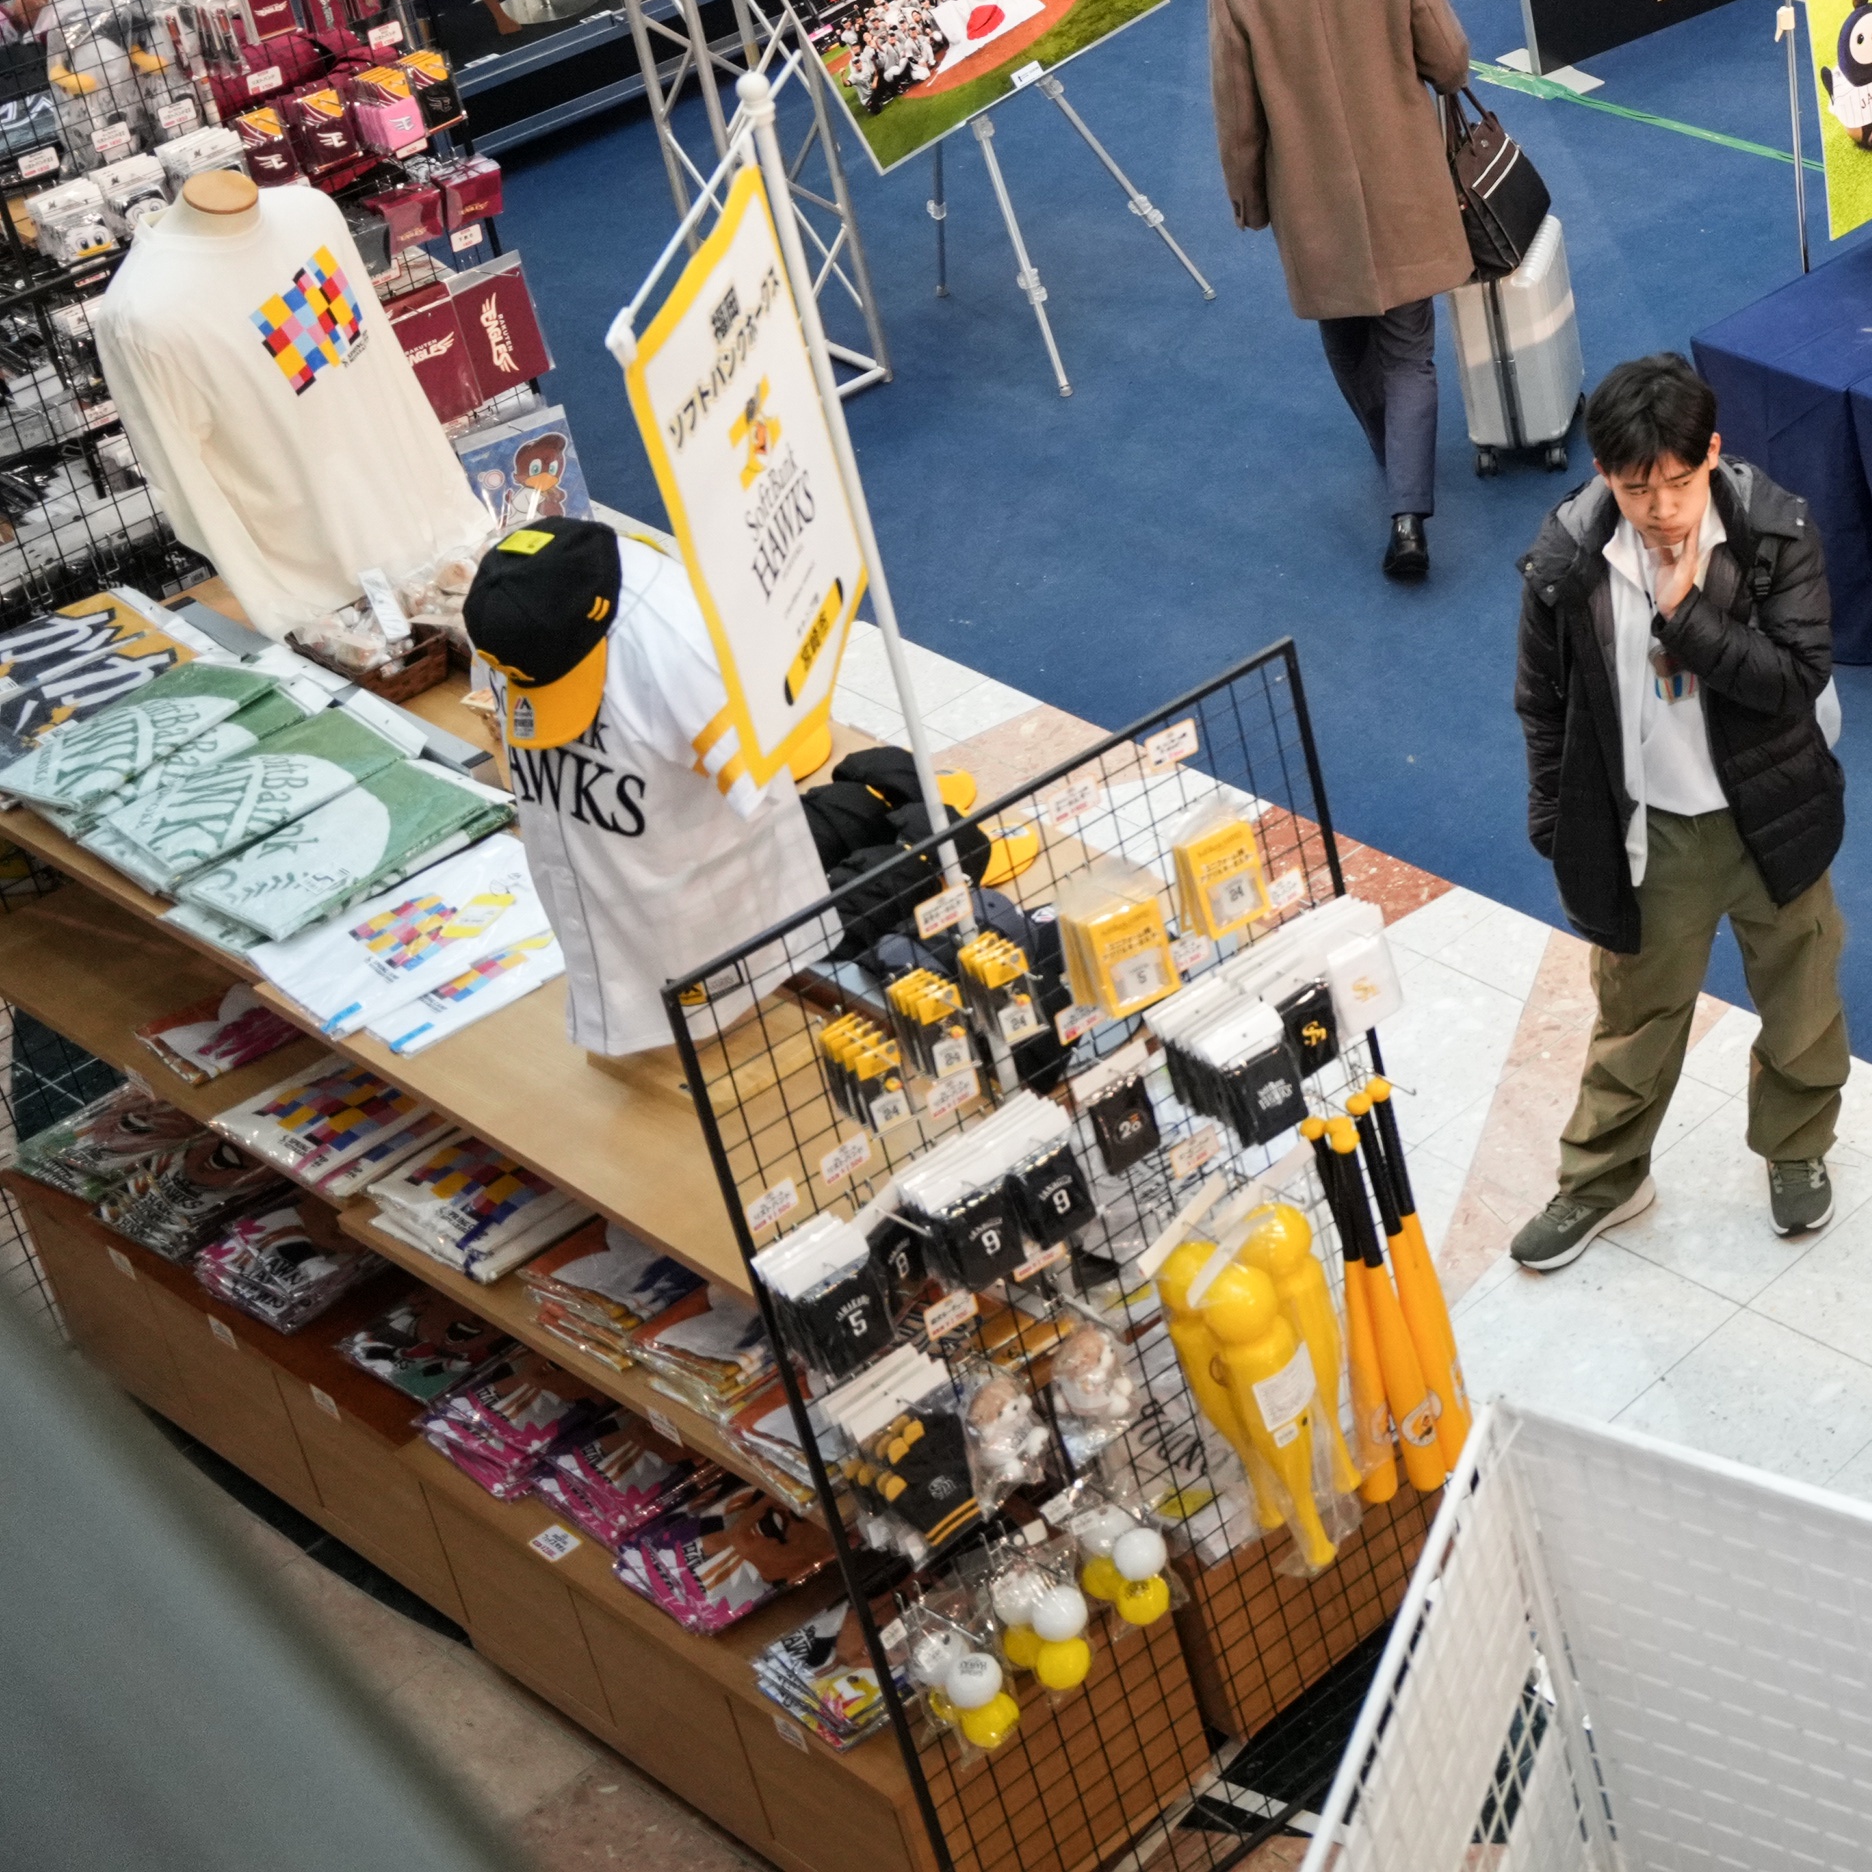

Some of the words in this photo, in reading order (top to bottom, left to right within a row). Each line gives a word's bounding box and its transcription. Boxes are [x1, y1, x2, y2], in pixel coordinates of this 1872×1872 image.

[498, 313, 513, 352] RAKUTEN
[668, 264, 782, 450] ソフトバンクホークス
[744, 443, 800, 542] SoftBank
[750, 470, 817, 605] HAWKS
[1051, 1188, 1072, 1215] 9
[980, 1229, 1001, 1256] 9
[848, 1309, 868, 1338] 5
